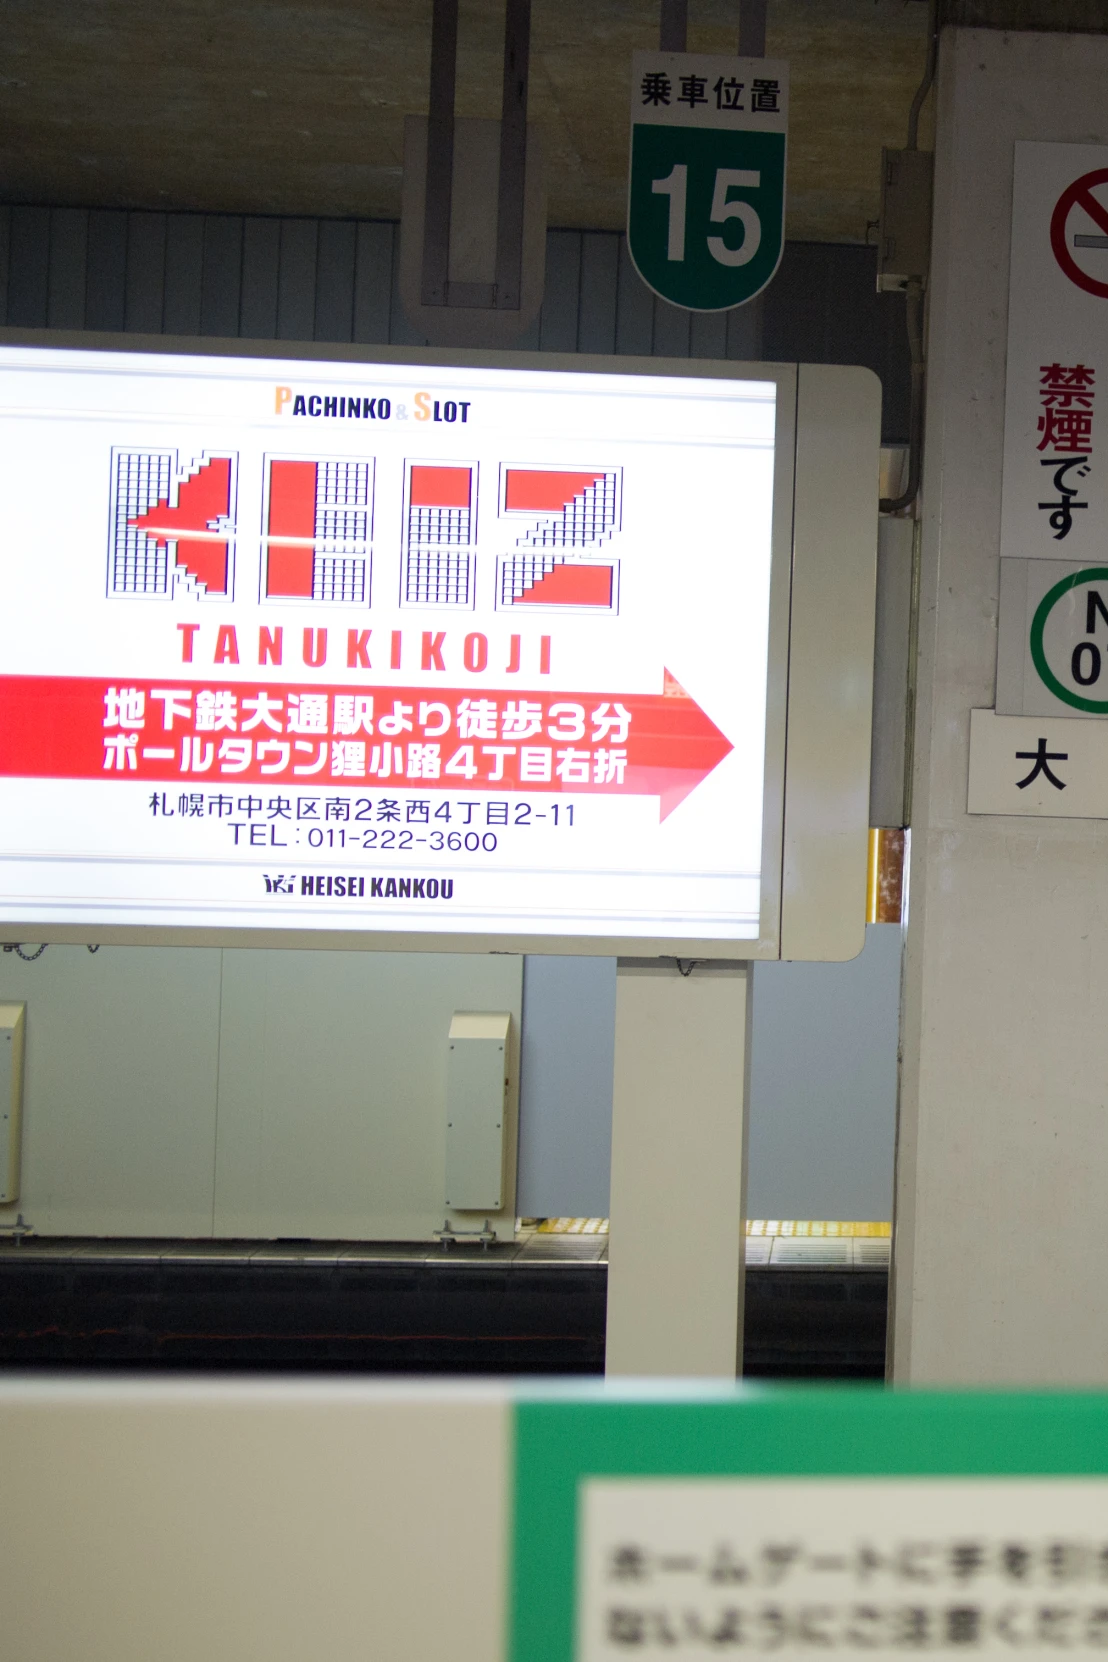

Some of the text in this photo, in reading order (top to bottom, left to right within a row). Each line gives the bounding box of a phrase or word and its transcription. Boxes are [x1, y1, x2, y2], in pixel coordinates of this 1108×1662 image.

[640, 72, 781, 114] 乗車位置
[651, 163, 761, 268] 15
[275, 386, 391, 421] PACHINKO
[413, 392, 471, 423] SLOT
[1036, 362, 1095, 540] 禁煙です
[176, 624, 552, 675] TANUKIKOJI
[103, 687, 631, 741] 地下鉄大通駅より徒歩3分
[103, 735, 628, 784] ポールタウン狸小路4丁目右折
[148, 792, 576, 827] 札幌市中央区南2条西4丁目2-11
[301, 875, 364, 897] HEISEI
[371, 877, 454, 899] KANKOU
